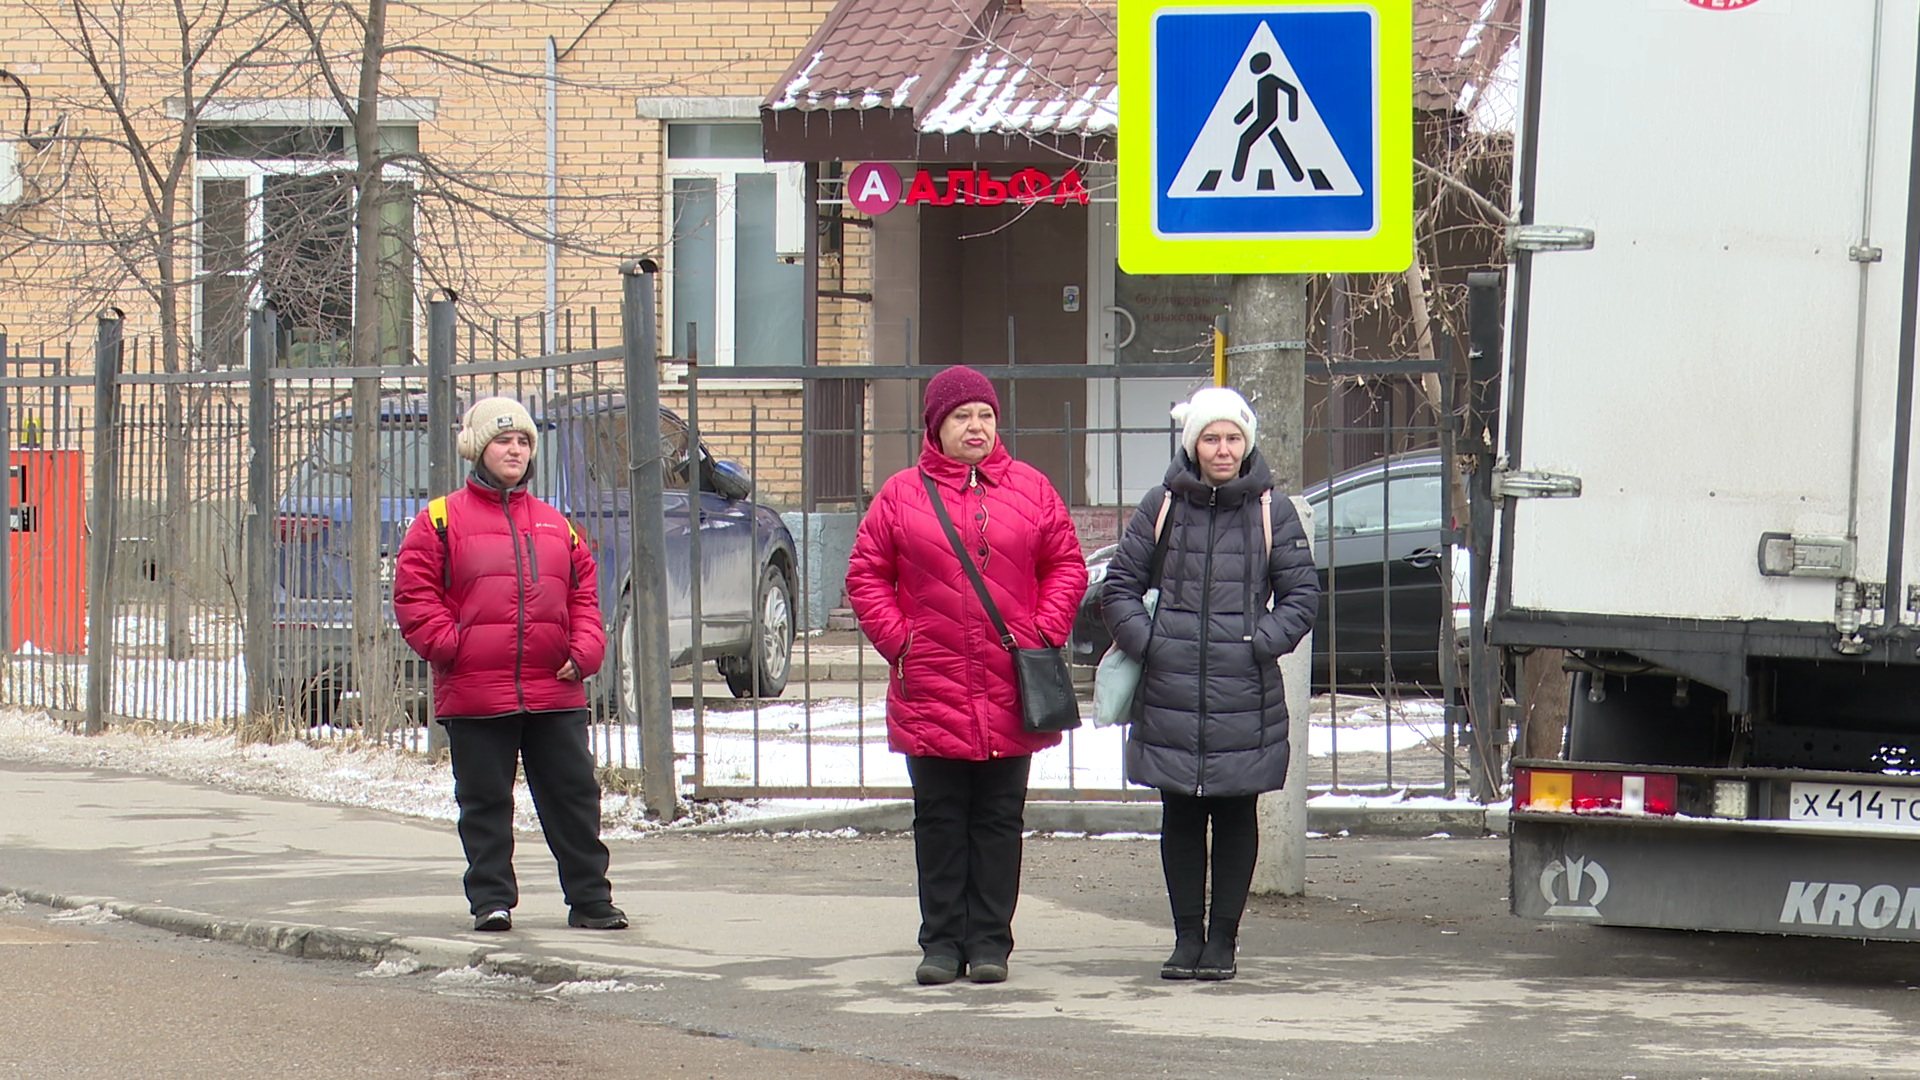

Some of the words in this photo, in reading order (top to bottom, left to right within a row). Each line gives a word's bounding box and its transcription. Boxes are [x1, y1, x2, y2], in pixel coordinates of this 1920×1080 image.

[858, 169, 890, 202] А
[904, 167, 1091, 207] АЛЬФА
[1154, 314, 1212, 322] выходны
